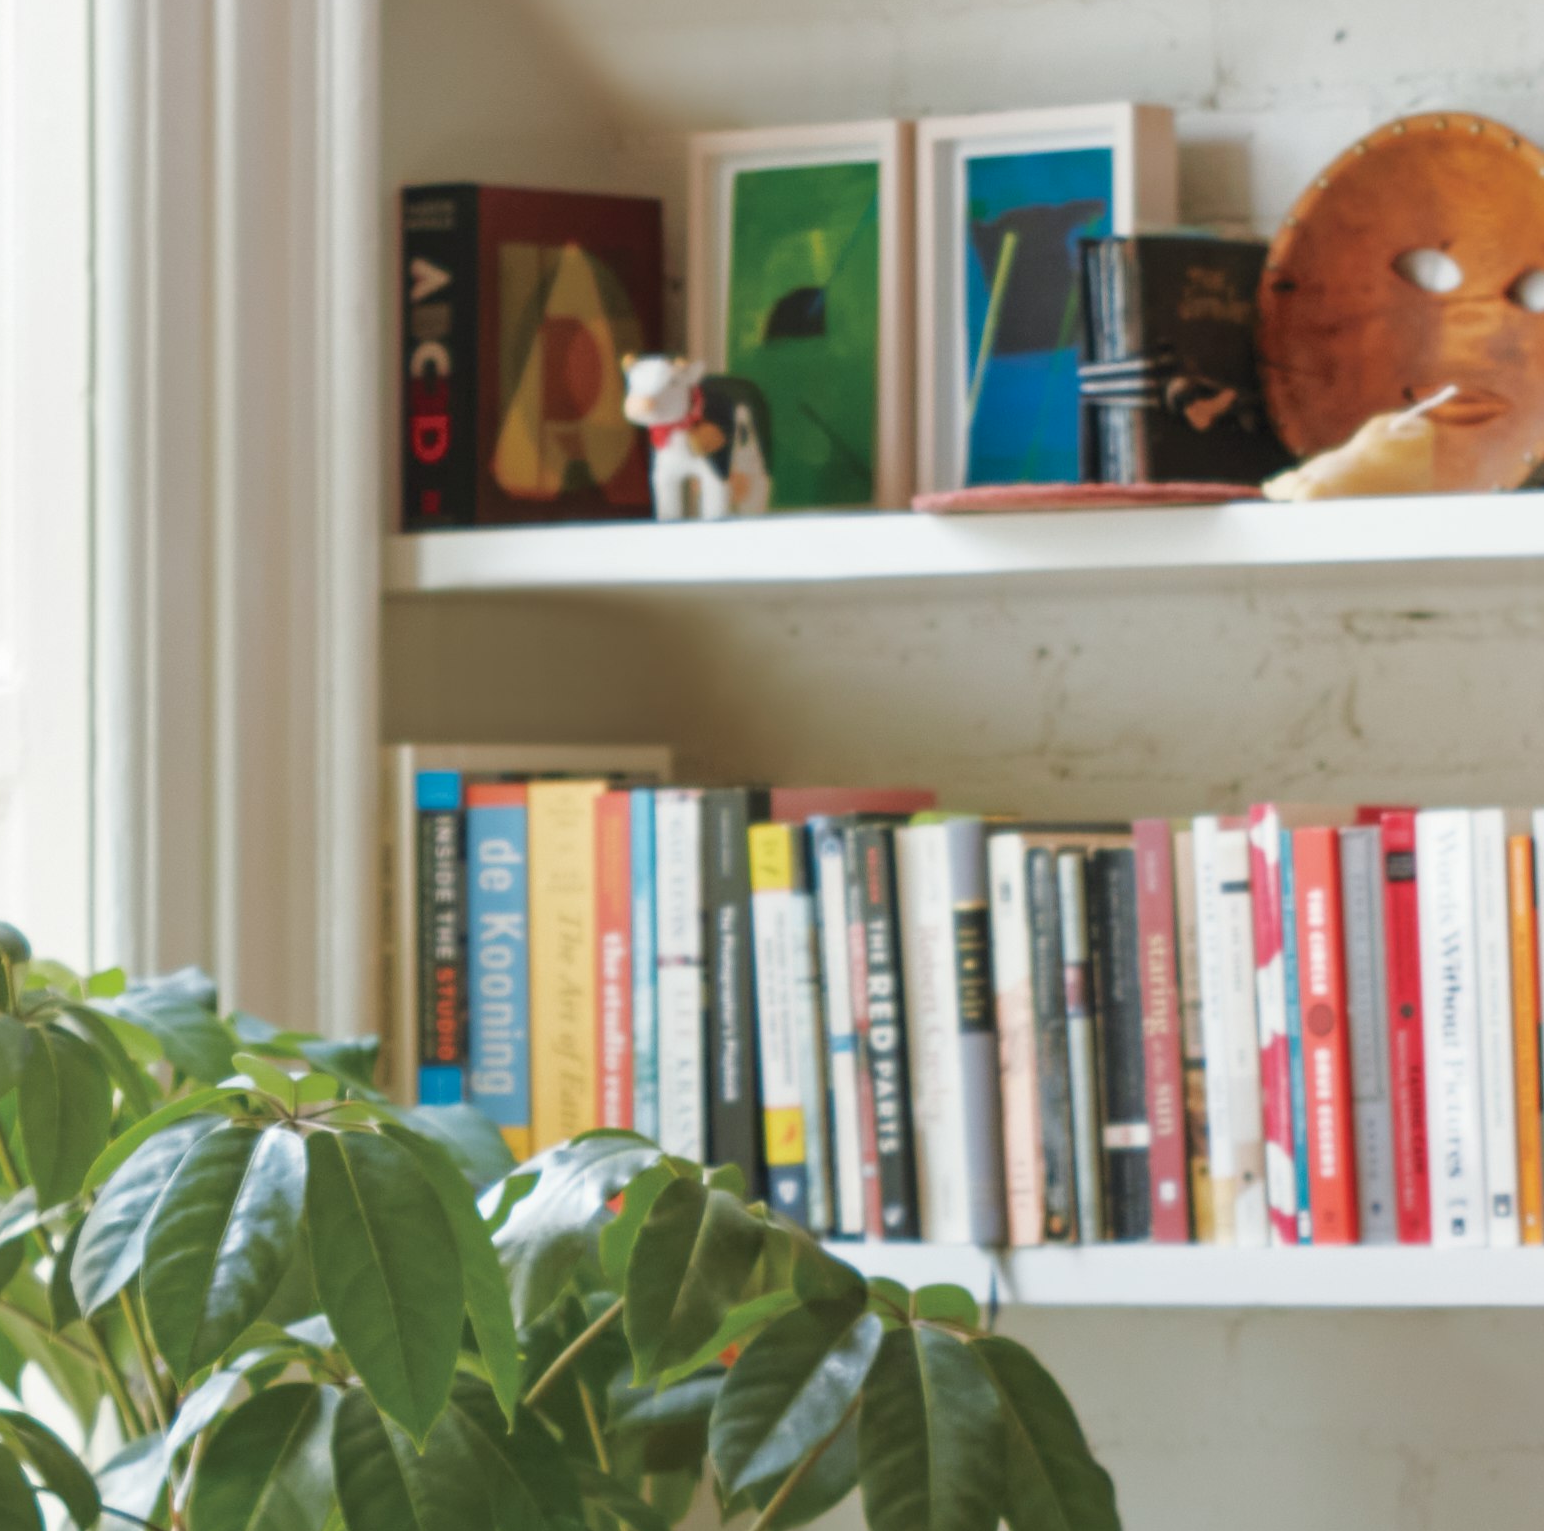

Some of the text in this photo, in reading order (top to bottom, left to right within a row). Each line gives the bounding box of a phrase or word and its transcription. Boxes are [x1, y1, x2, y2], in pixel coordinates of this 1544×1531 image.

[435, 814, 456, 1061] INSIDE THE STUDIO
[471, 838, 525, 1095] de Kooning
[869, 920, 901, 1154] THE RED PARTS
[1143, 933, 1176, 1136] staring sun
